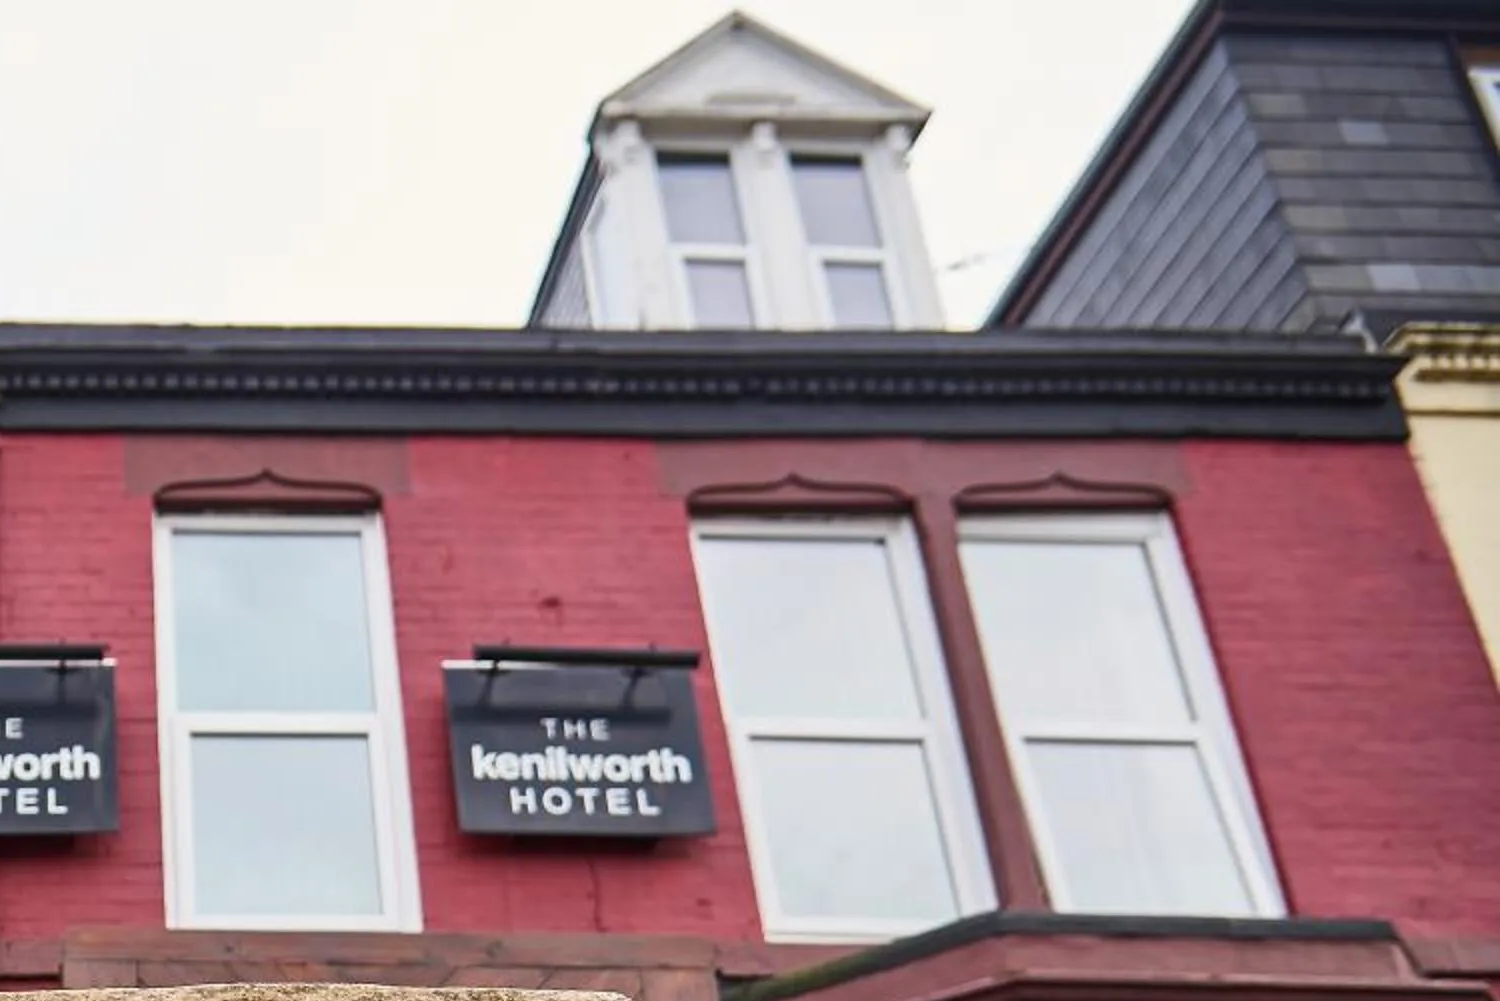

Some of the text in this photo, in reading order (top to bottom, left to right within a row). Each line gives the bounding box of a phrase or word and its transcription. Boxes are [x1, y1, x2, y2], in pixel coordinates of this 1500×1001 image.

[541, 717, 609, 741] THE
[471, 744, 693, 784] kenilworth
[508, 786, 661, 817] HOTEL
